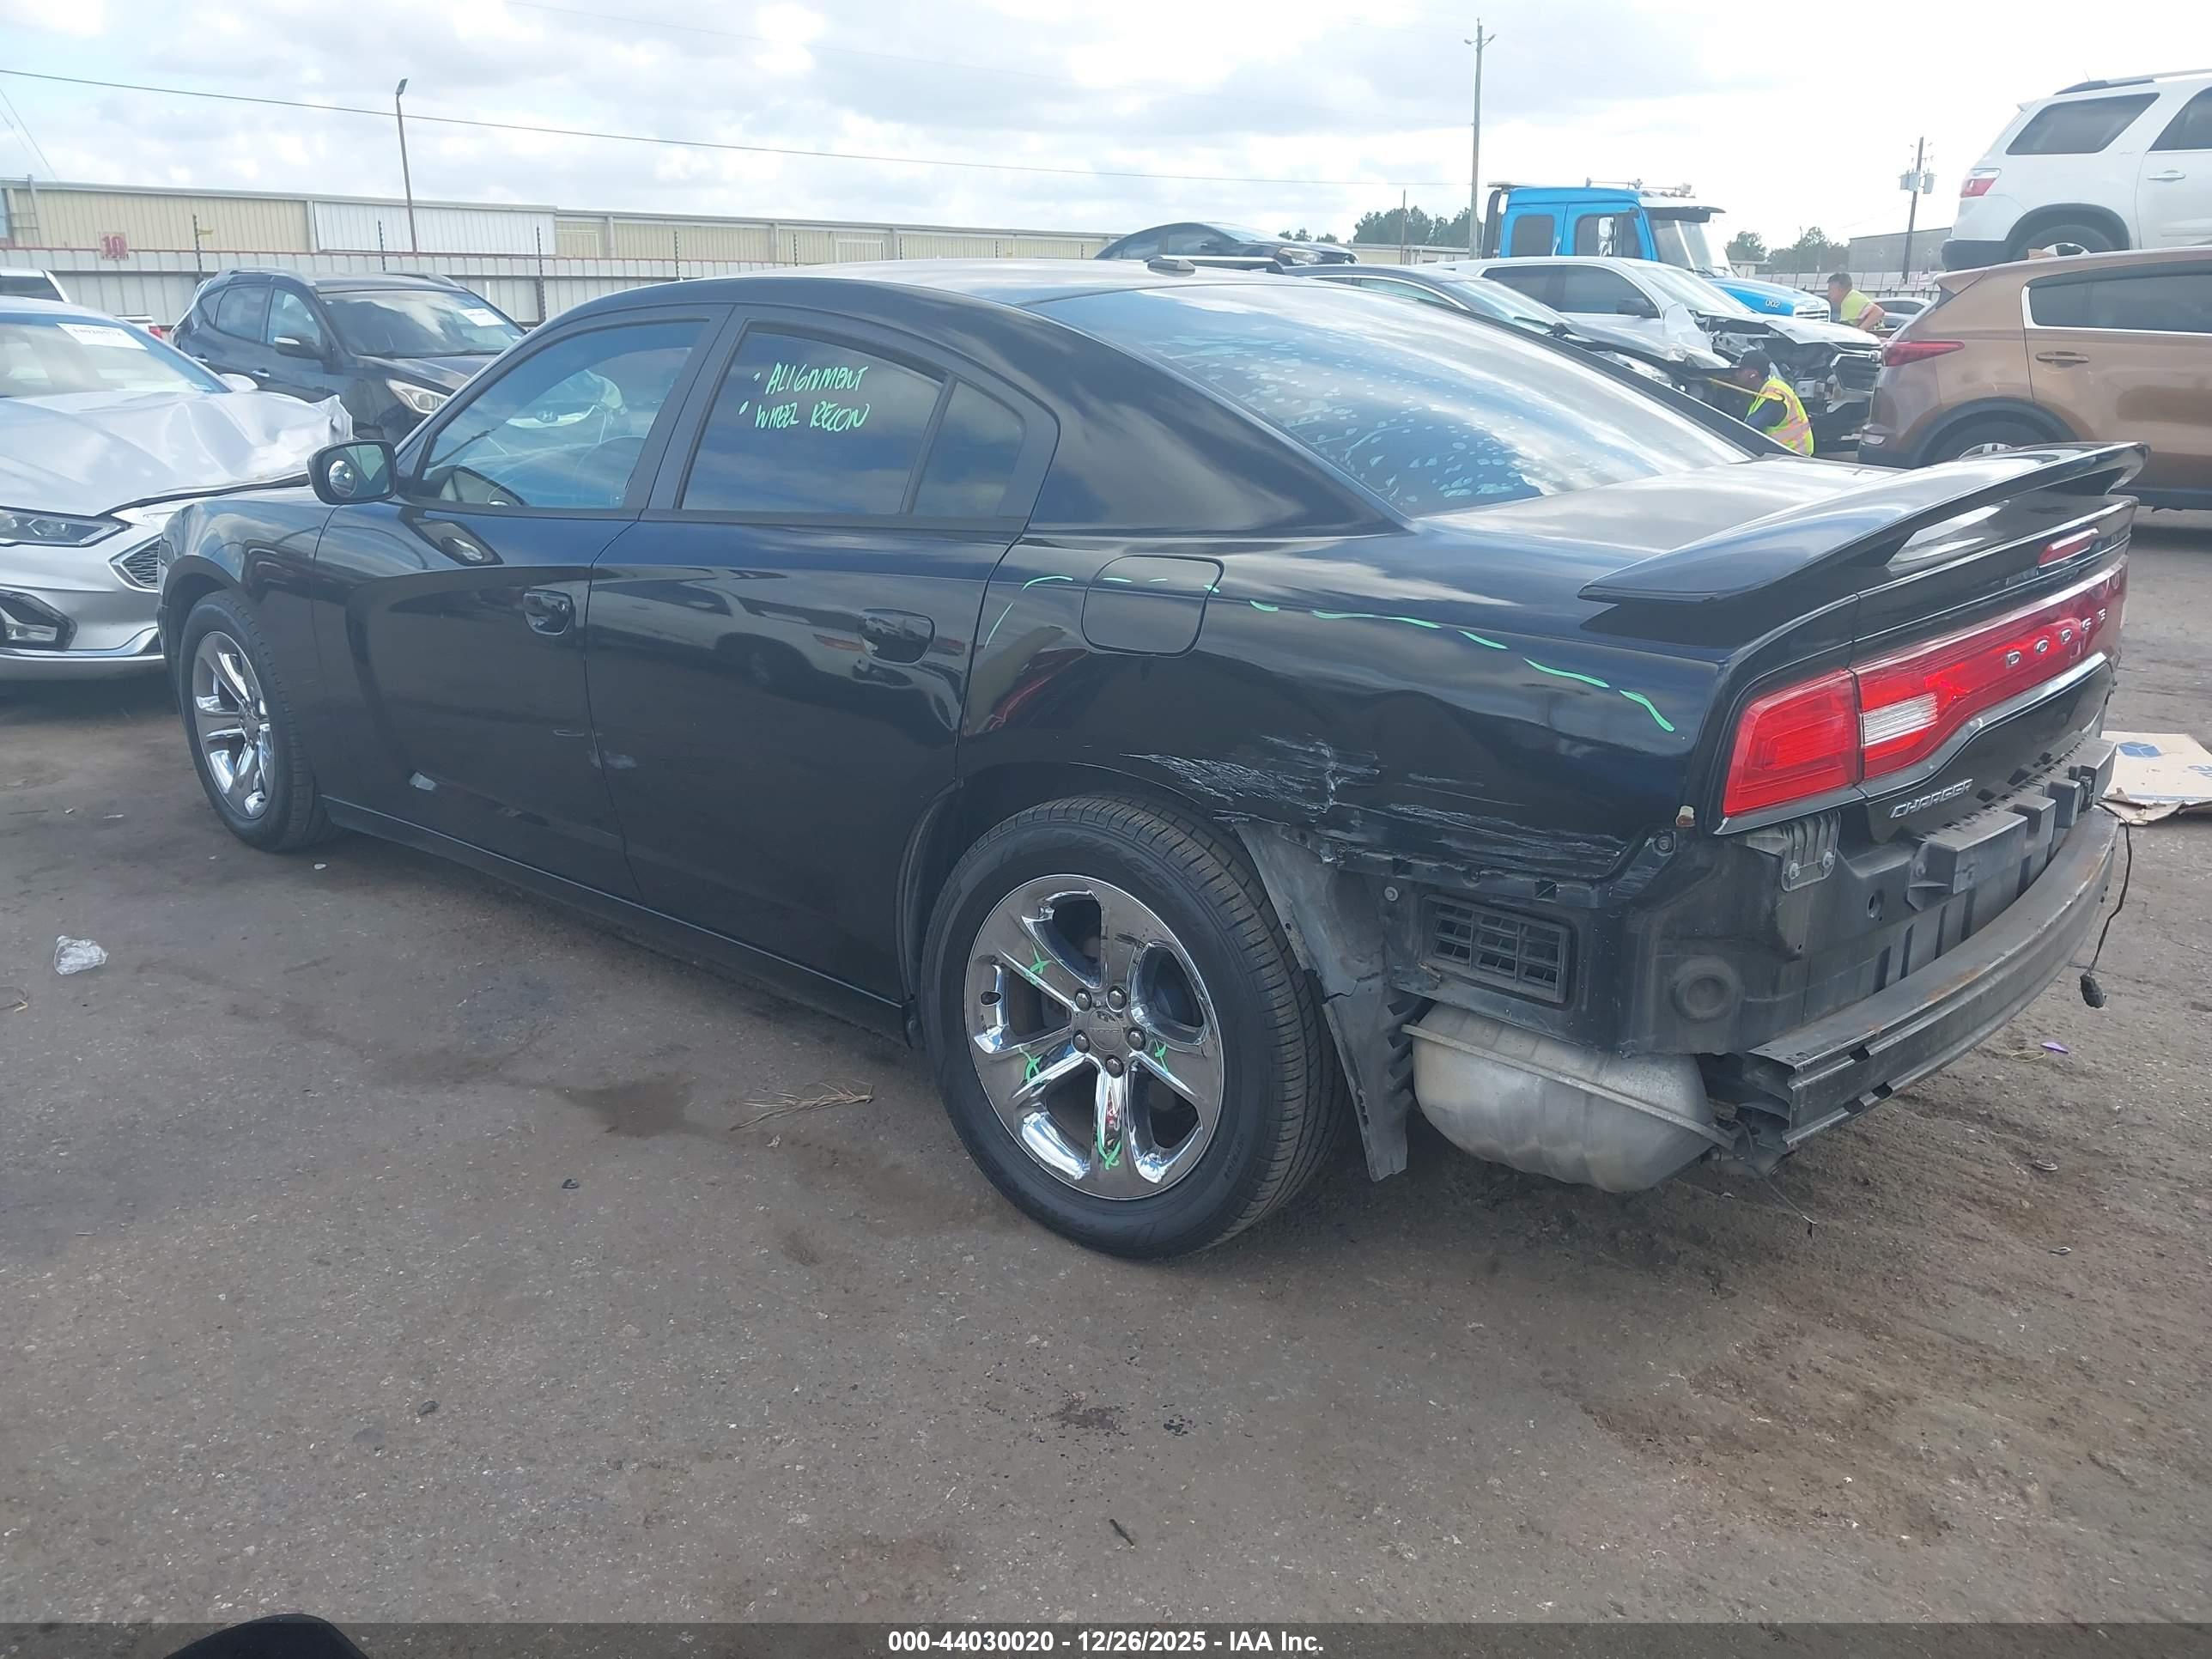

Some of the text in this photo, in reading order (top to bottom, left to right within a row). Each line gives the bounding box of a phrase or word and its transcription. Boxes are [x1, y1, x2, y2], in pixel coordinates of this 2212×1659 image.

[809, 400, 871, 432] RECON
[2007, 608, 2106, 665] DODGE
[1889, 778, 1973, 818] CHARGER
